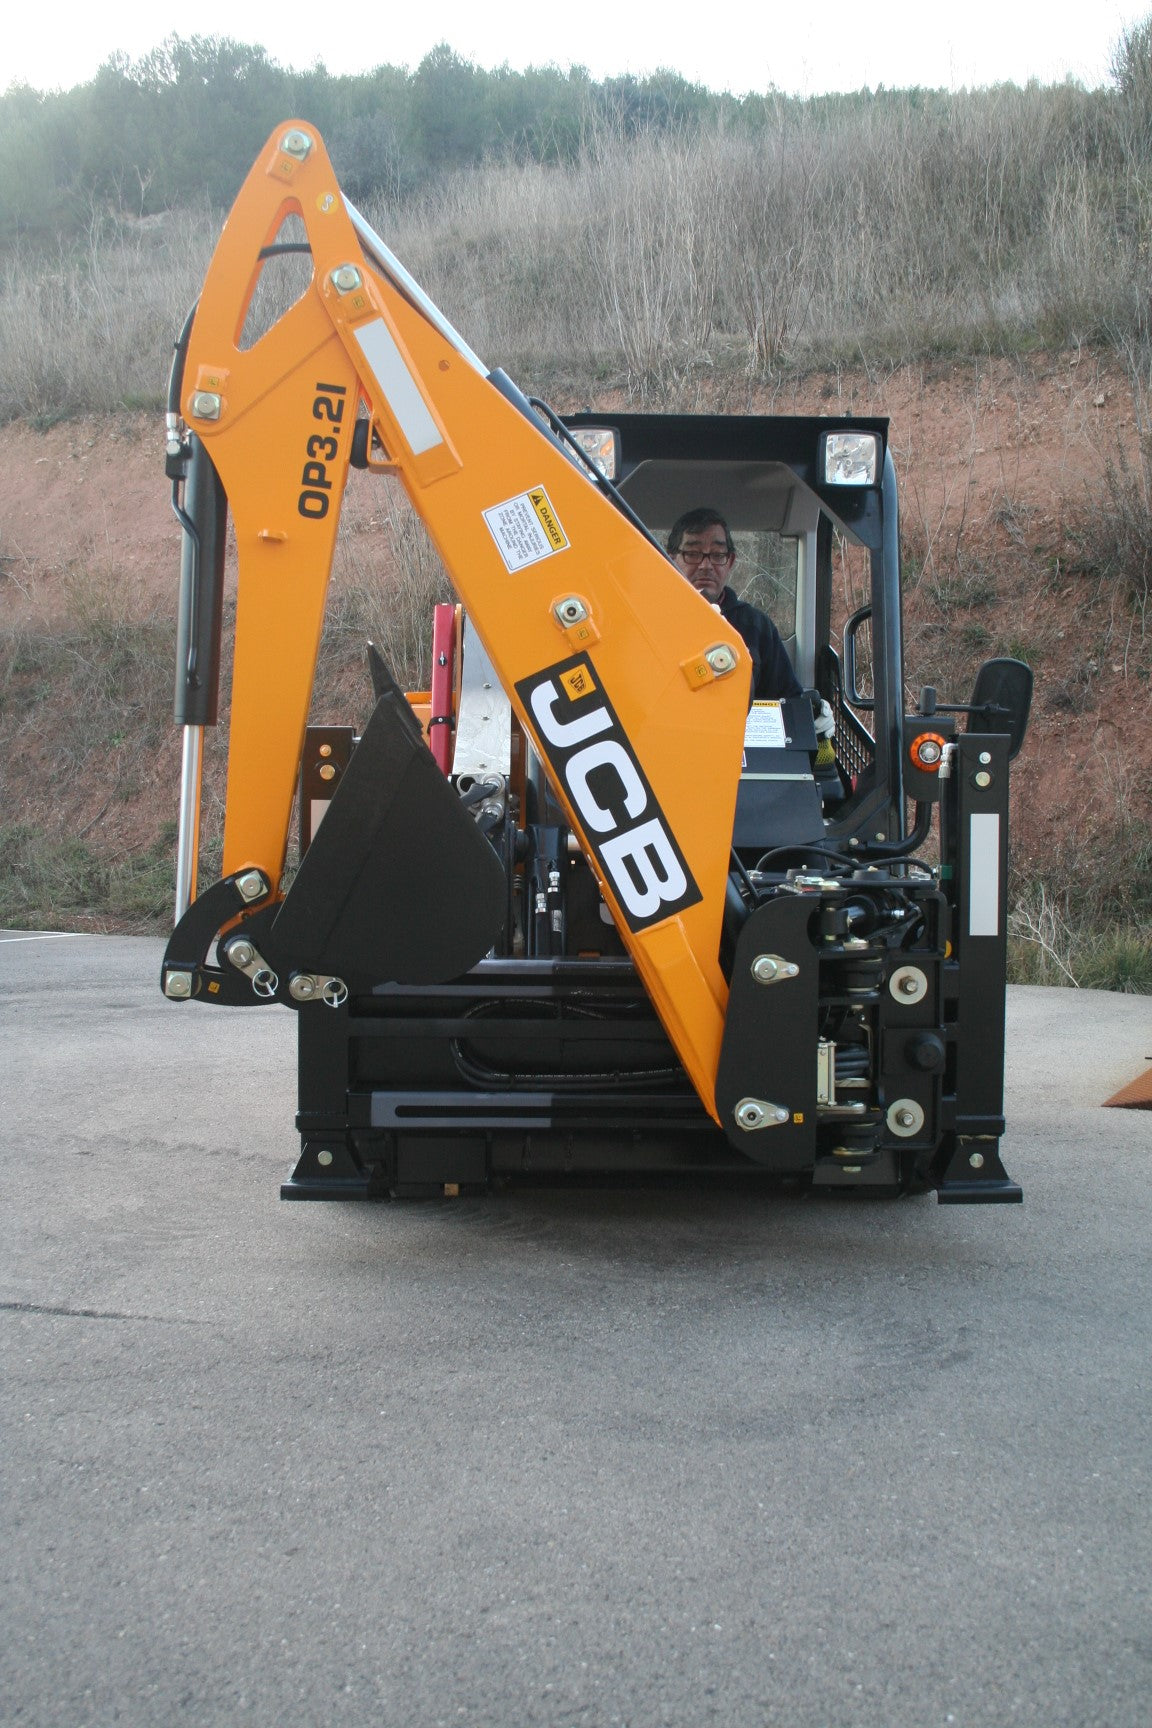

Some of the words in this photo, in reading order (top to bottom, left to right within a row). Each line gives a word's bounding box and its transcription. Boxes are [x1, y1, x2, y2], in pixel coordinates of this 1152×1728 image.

[497, 511, 507, 526] ZONE
[515, 550, 523, 560] THE
[498, 526, 512, 549] MACHINE
[503, 509, 513, 524] FROM
[510, 525, 518, 535] THE
[515, 536, 528, 558] DANGER
[513, 502, 520, 511] OR
[517, 510, 529, 531] MORTAL
[519, 502, 533, 526] PREVENT
[530, 526, 544, 550] SERIOUS
[539, 506, 561, 544] DANGER
[570, 673, 585, 692] JCB
[530, 680, 688, 918] JCB
